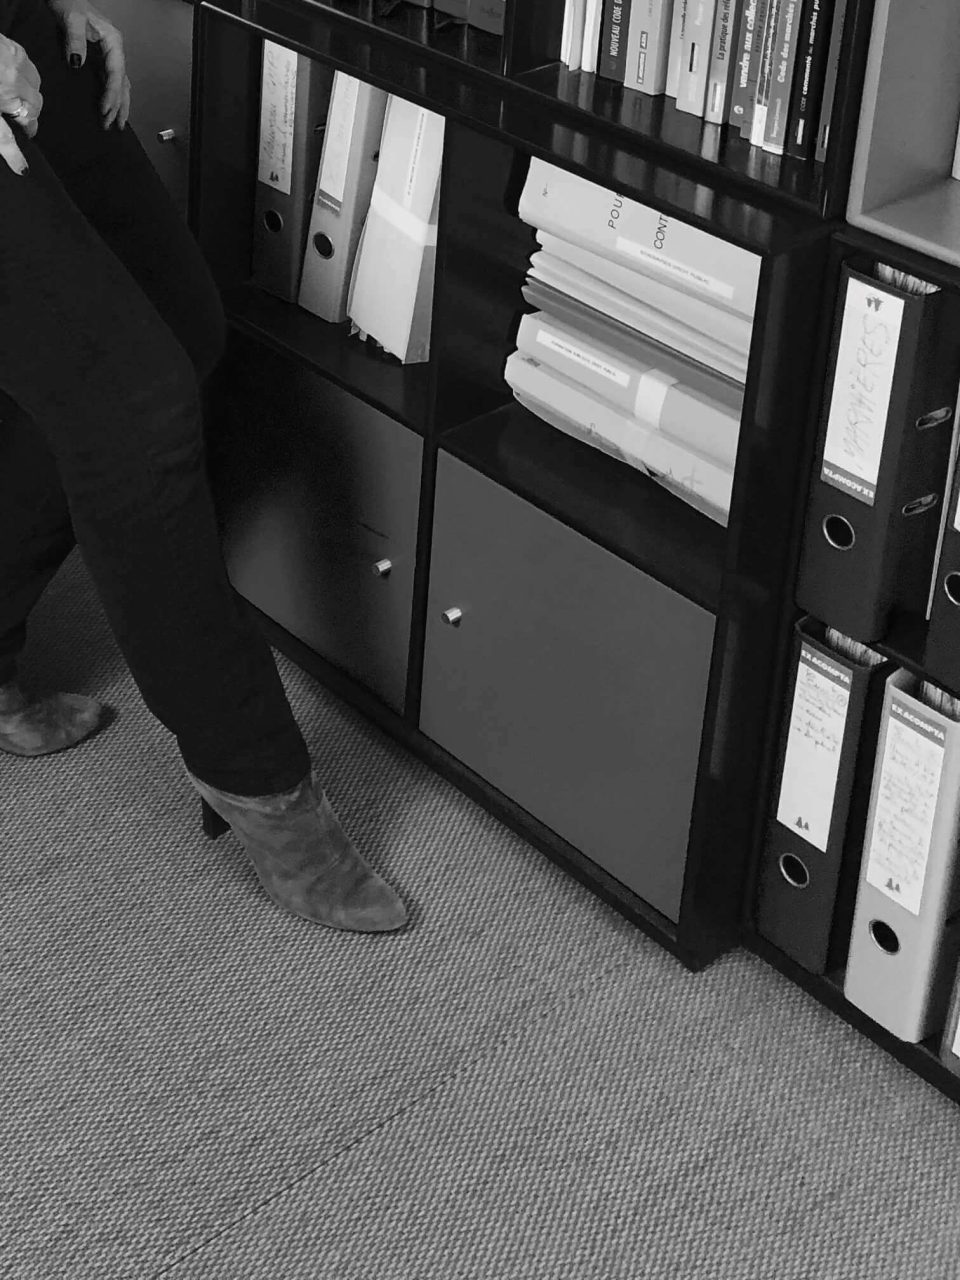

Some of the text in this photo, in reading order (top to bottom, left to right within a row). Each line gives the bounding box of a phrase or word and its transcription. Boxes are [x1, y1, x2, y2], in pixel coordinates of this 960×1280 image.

[614, 5, 623, 24] CODE
[721, 11, 730, 23] des
[784, 2, 795, 42] marchés
[611, 24, 620, 57] NOUVEAU
[718, 24, 729, 53] pratique
[781, 42, 790, 59] des
[802, 56, 812, 96] commenté
[809, 11, 818, 45] marchés
[717, 51, 725, 61] La
[738, 52, 750, 89] vendre
[744, 32, 753, 52] aux
[777, 59, 788, 84] Code
[653, 215, 669, 250] CONT
[801, 649, 851, 685] EXACOMPTA
[891, 703, 945, 741] EXACOMPTA
